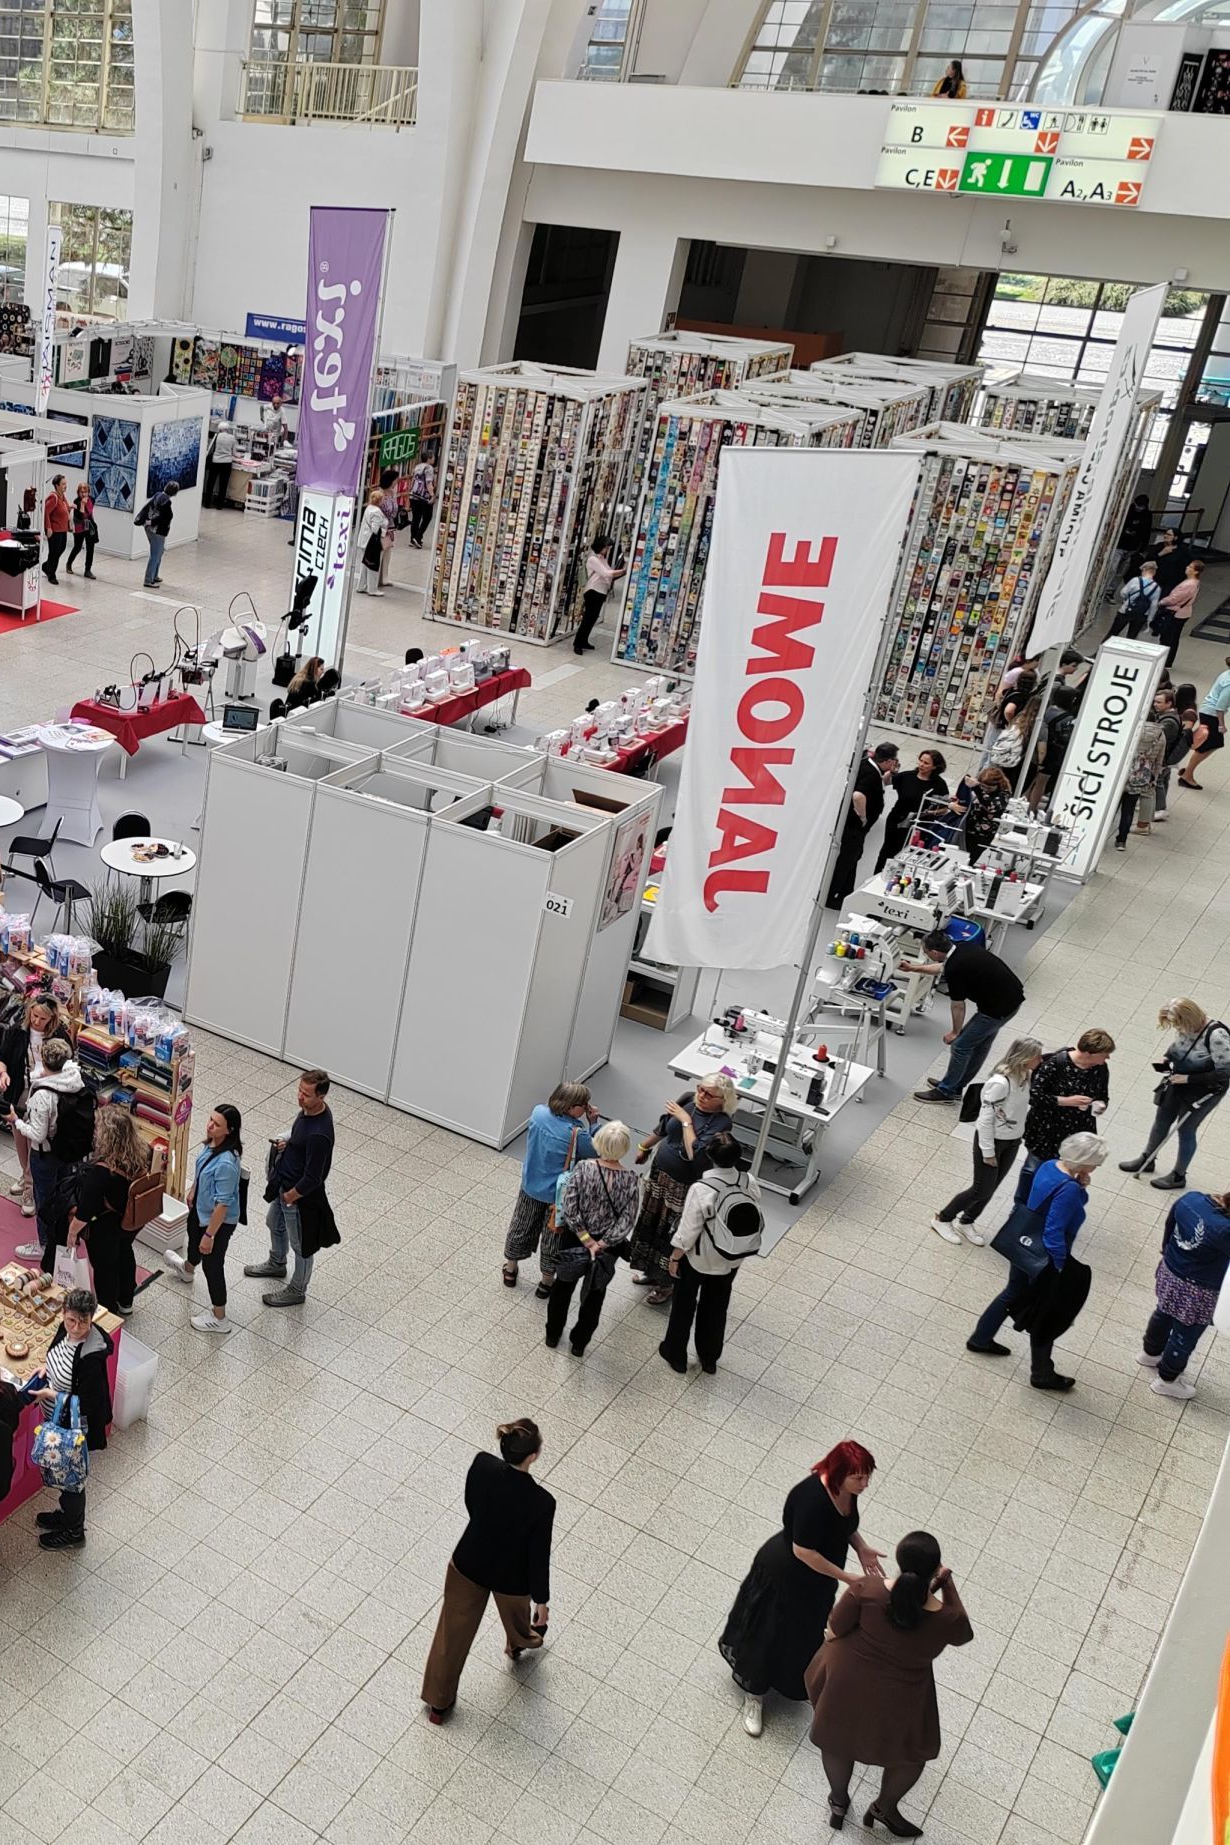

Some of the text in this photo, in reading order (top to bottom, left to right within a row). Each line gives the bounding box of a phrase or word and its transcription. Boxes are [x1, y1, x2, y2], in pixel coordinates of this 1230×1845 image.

[890, 104, 917, 113] Pavilon
[911, 126, 924, 143] B
[880, 146, 907, 155] Pavilon
[1055, 157, 1084, 168] Pavilon
[905, 168, 935, 189] C,E
[382, 433, 416, 460] RAGOS
[333, 510, 351, 571] texi
[1086, 664, 1139, 766] STROJE
[546, 899, 567, 916] 021
[883, 905, 910, 919] texi
